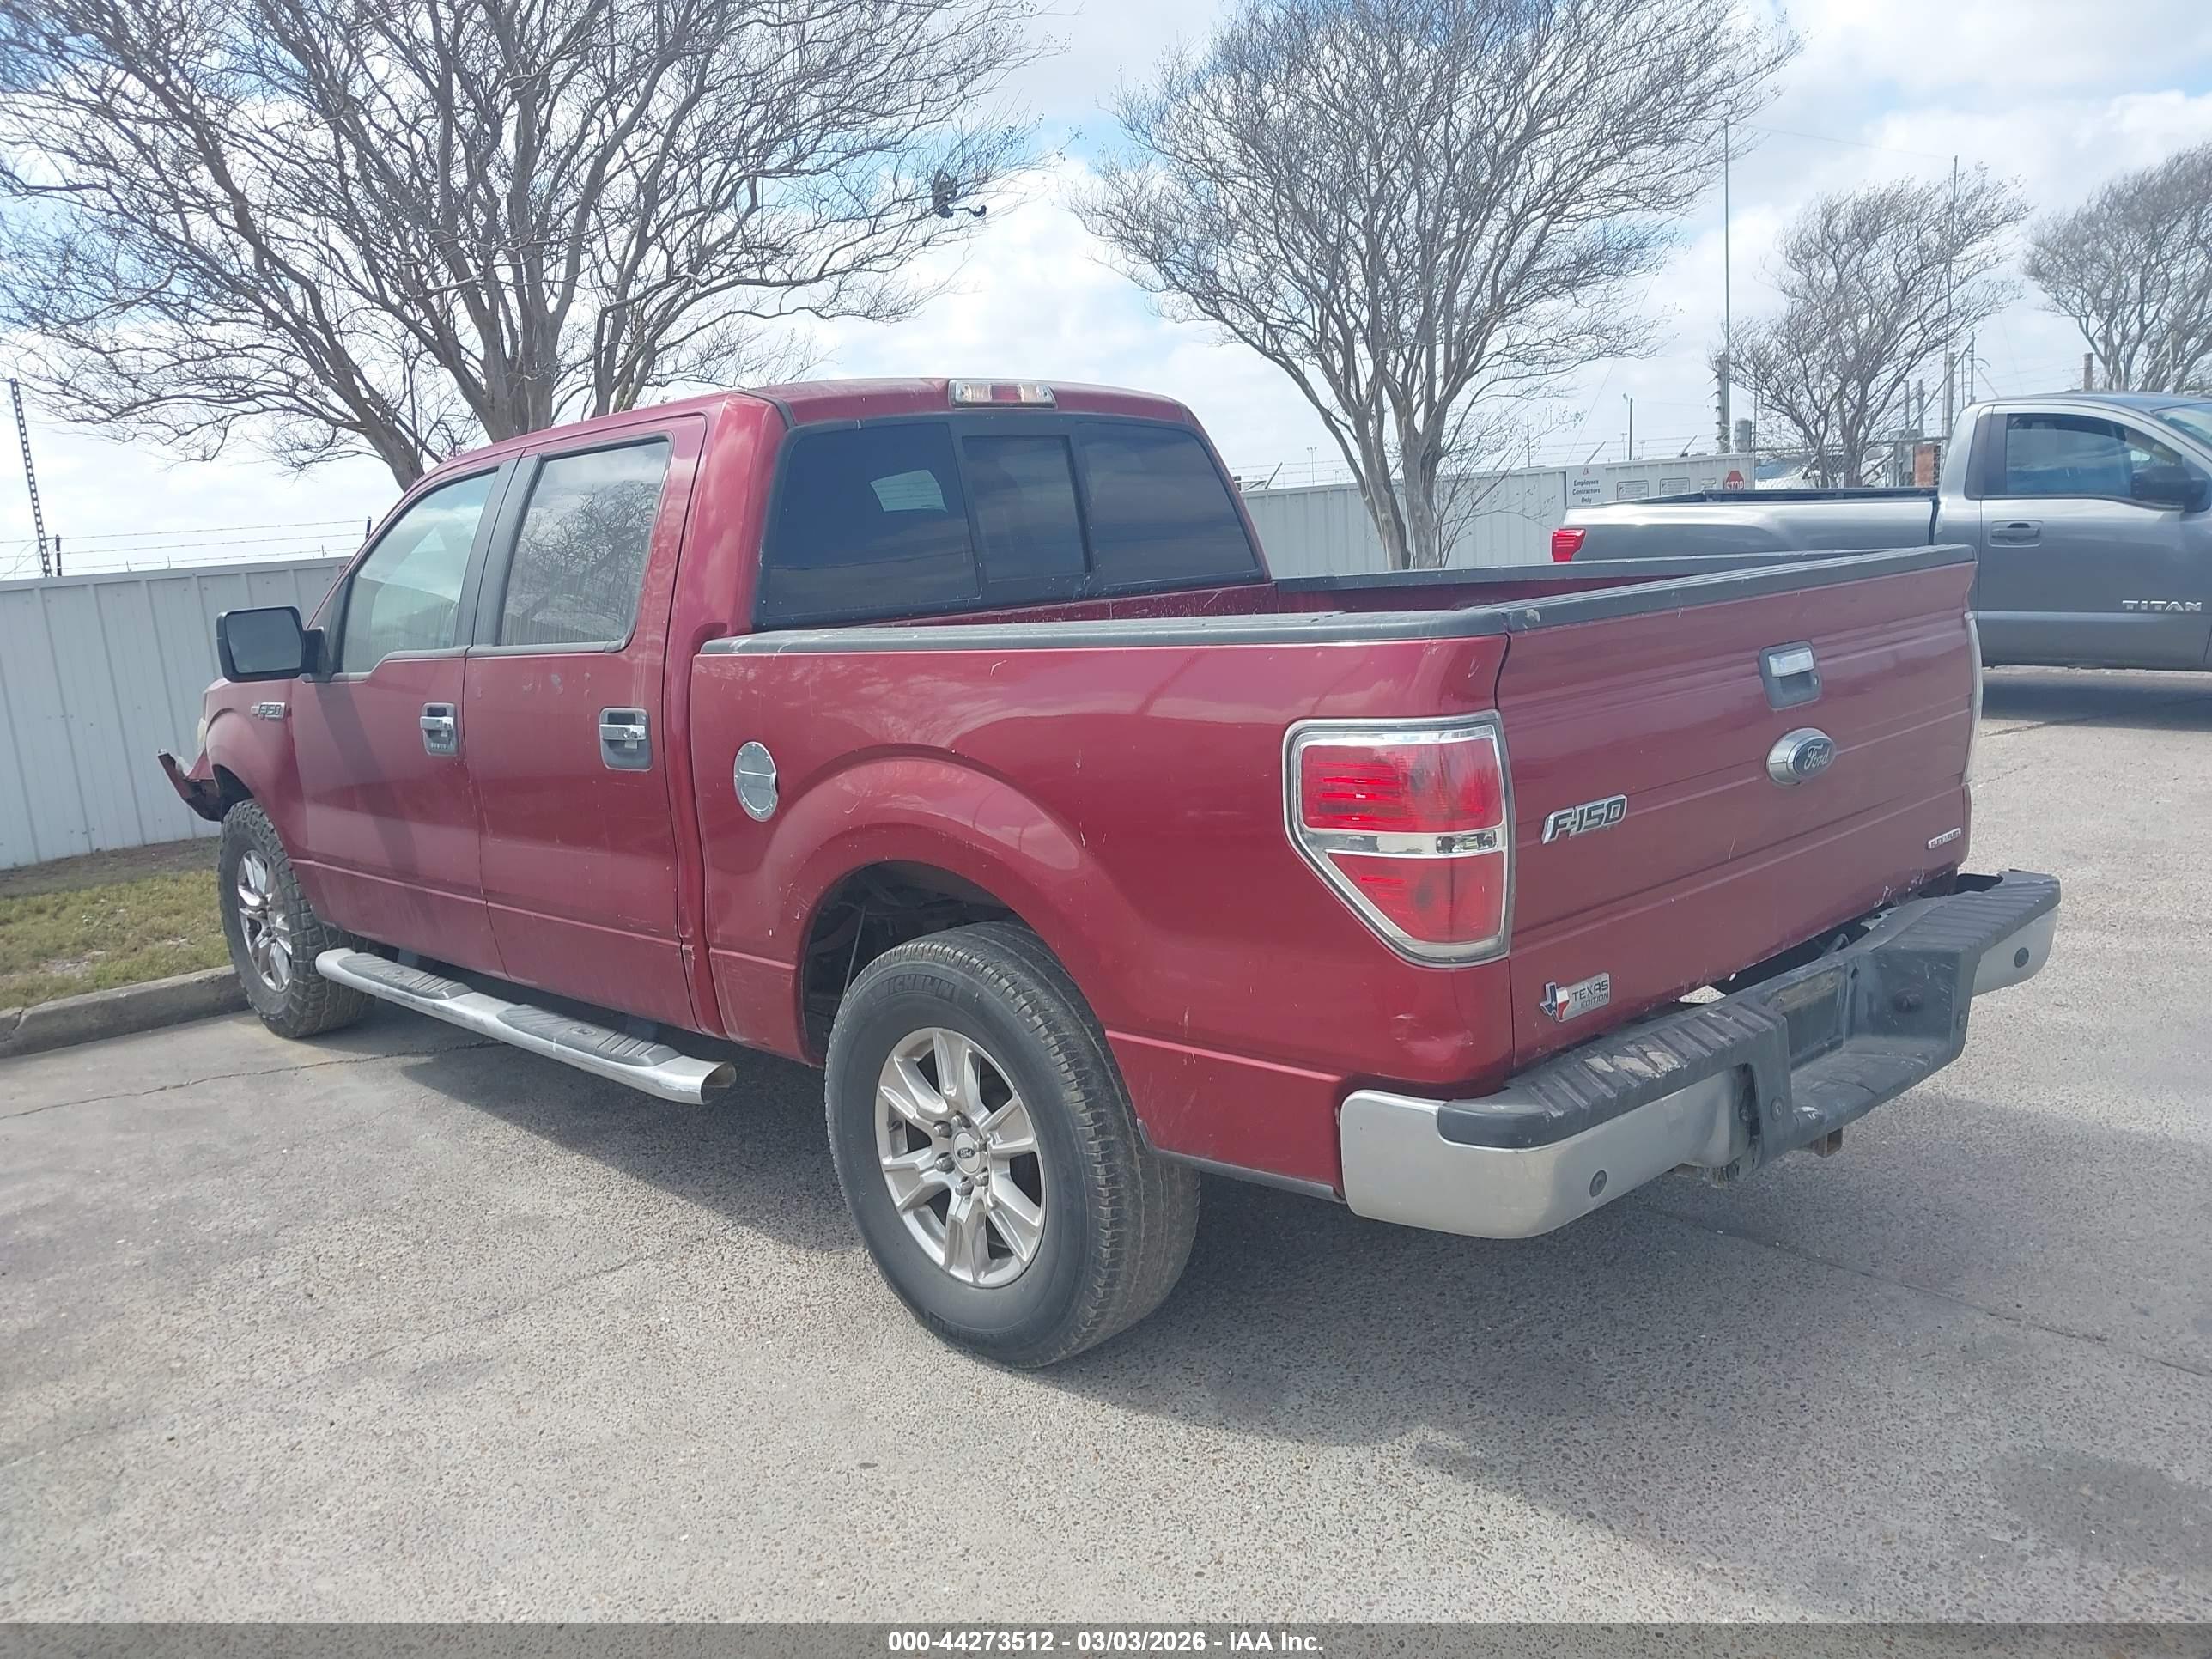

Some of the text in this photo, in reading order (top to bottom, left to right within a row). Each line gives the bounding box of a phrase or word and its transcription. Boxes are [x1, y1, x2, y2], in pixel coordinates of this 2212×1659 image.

[1727, 481, 1744, 490] STOP
[1581, 495, 1592, 504] Only
[2122, 600, 2203, 611] TITAN
[1804, 744, 1830, 770] Ford
[1542, 794, 1627, 844] F-150
[1571, 980, 1608, 1002] TEXAS
[1581, 993, 1608, 1008] EDITION
